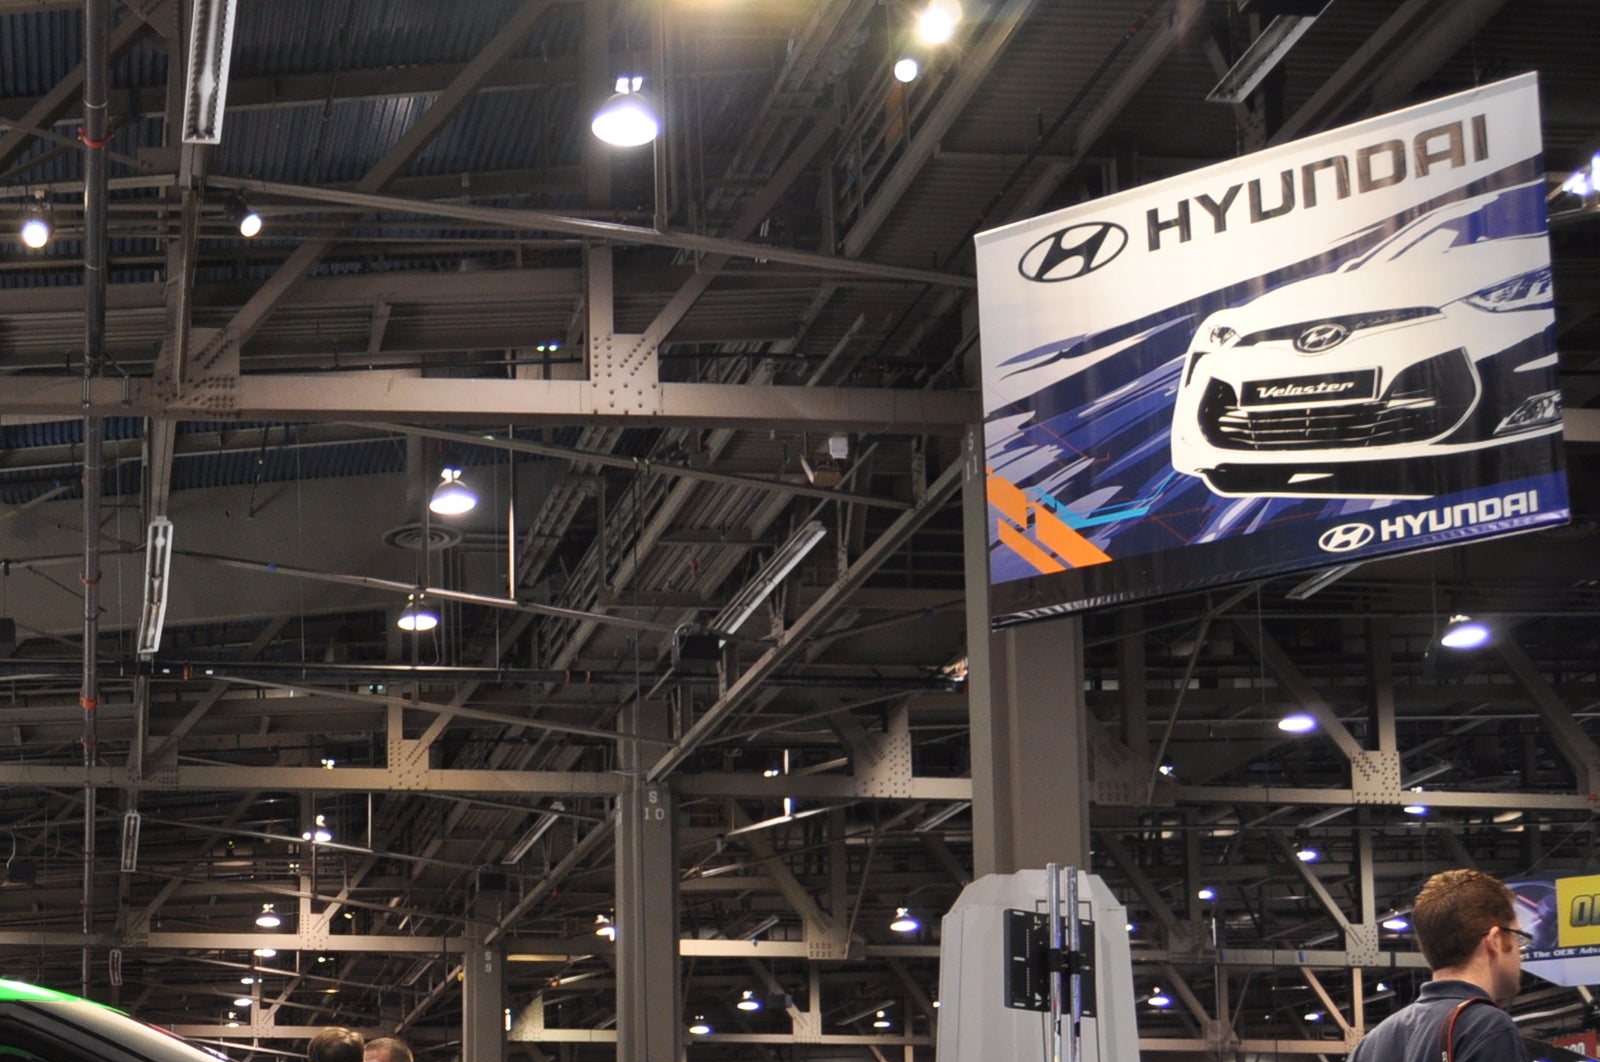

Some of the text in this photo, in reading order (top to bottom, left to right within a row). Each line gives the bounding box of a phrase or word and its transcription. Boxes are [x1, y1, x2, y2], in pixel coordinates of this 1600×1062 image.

[1146, 114, 1490, 252] HYUNDAI
[1256, 381, 1354, 399] Veloster
[1380, 489, 1539, 542] HYUNDAI
[644, 807, 665, 821] 10
